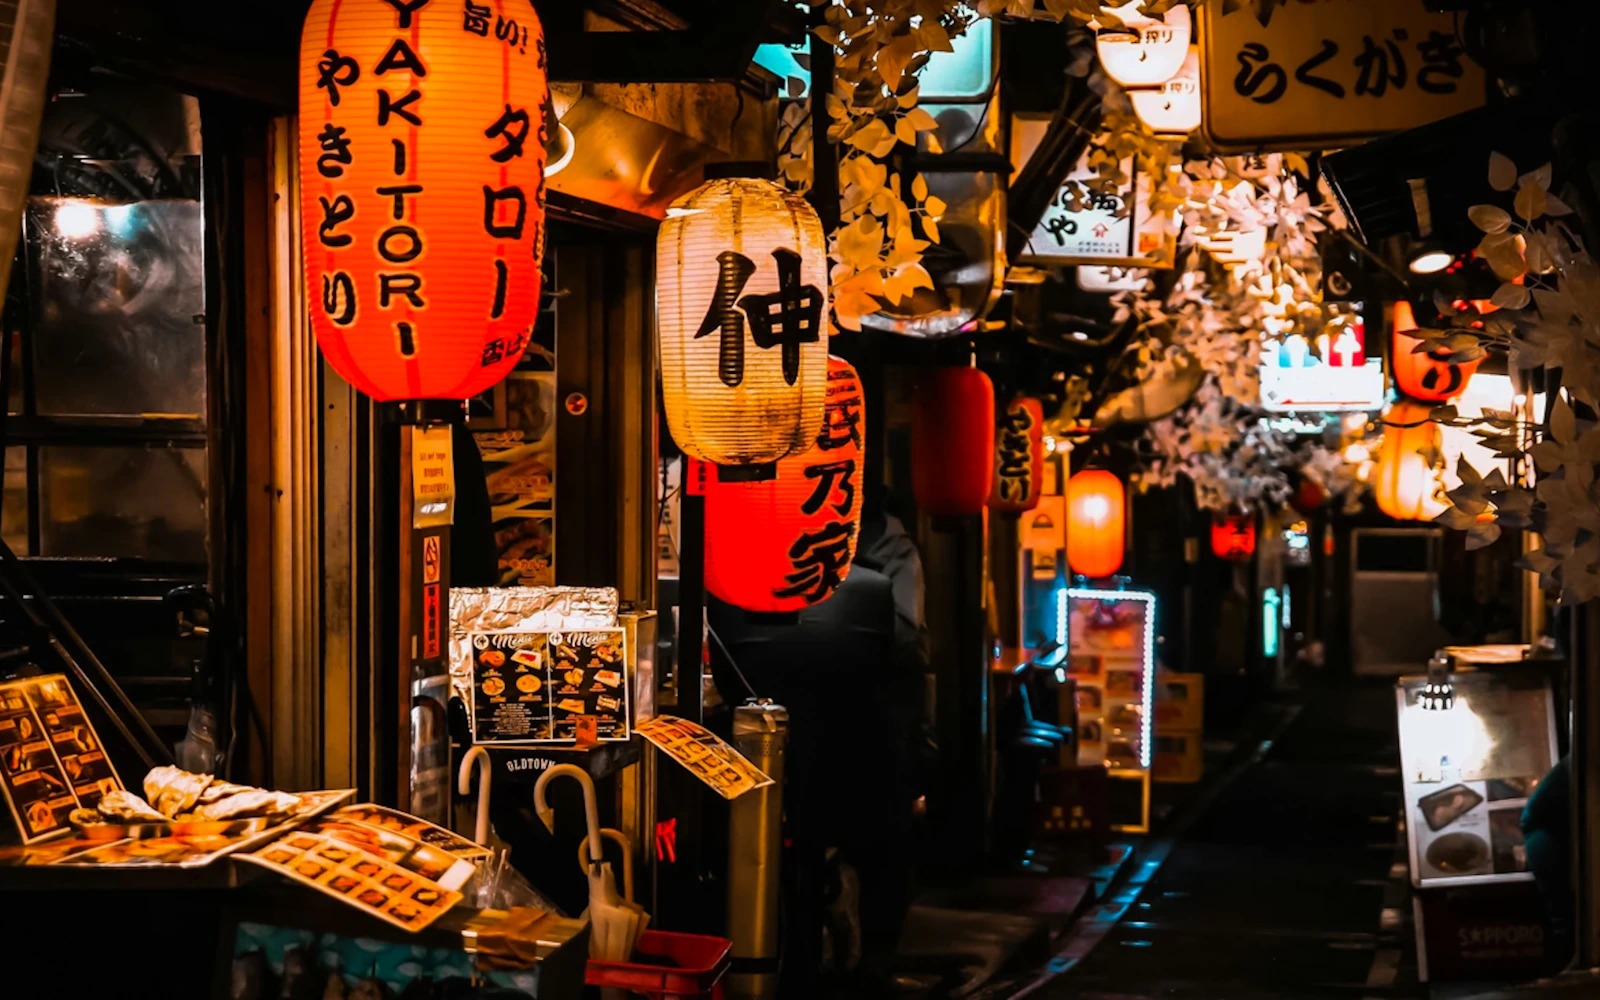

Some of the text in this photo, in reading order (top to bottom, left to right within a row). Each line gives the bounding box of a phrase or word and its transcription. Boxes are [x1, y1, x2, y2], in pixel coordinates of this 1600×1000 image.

[1234, 28, 1464, 104] らくがき
[316, 48, 361, 326] やきとり
[373, 0, 432, 357] YAKITORI
[483, 103, 530, 320] タロー
[693, 246, 825, 387] 伸
